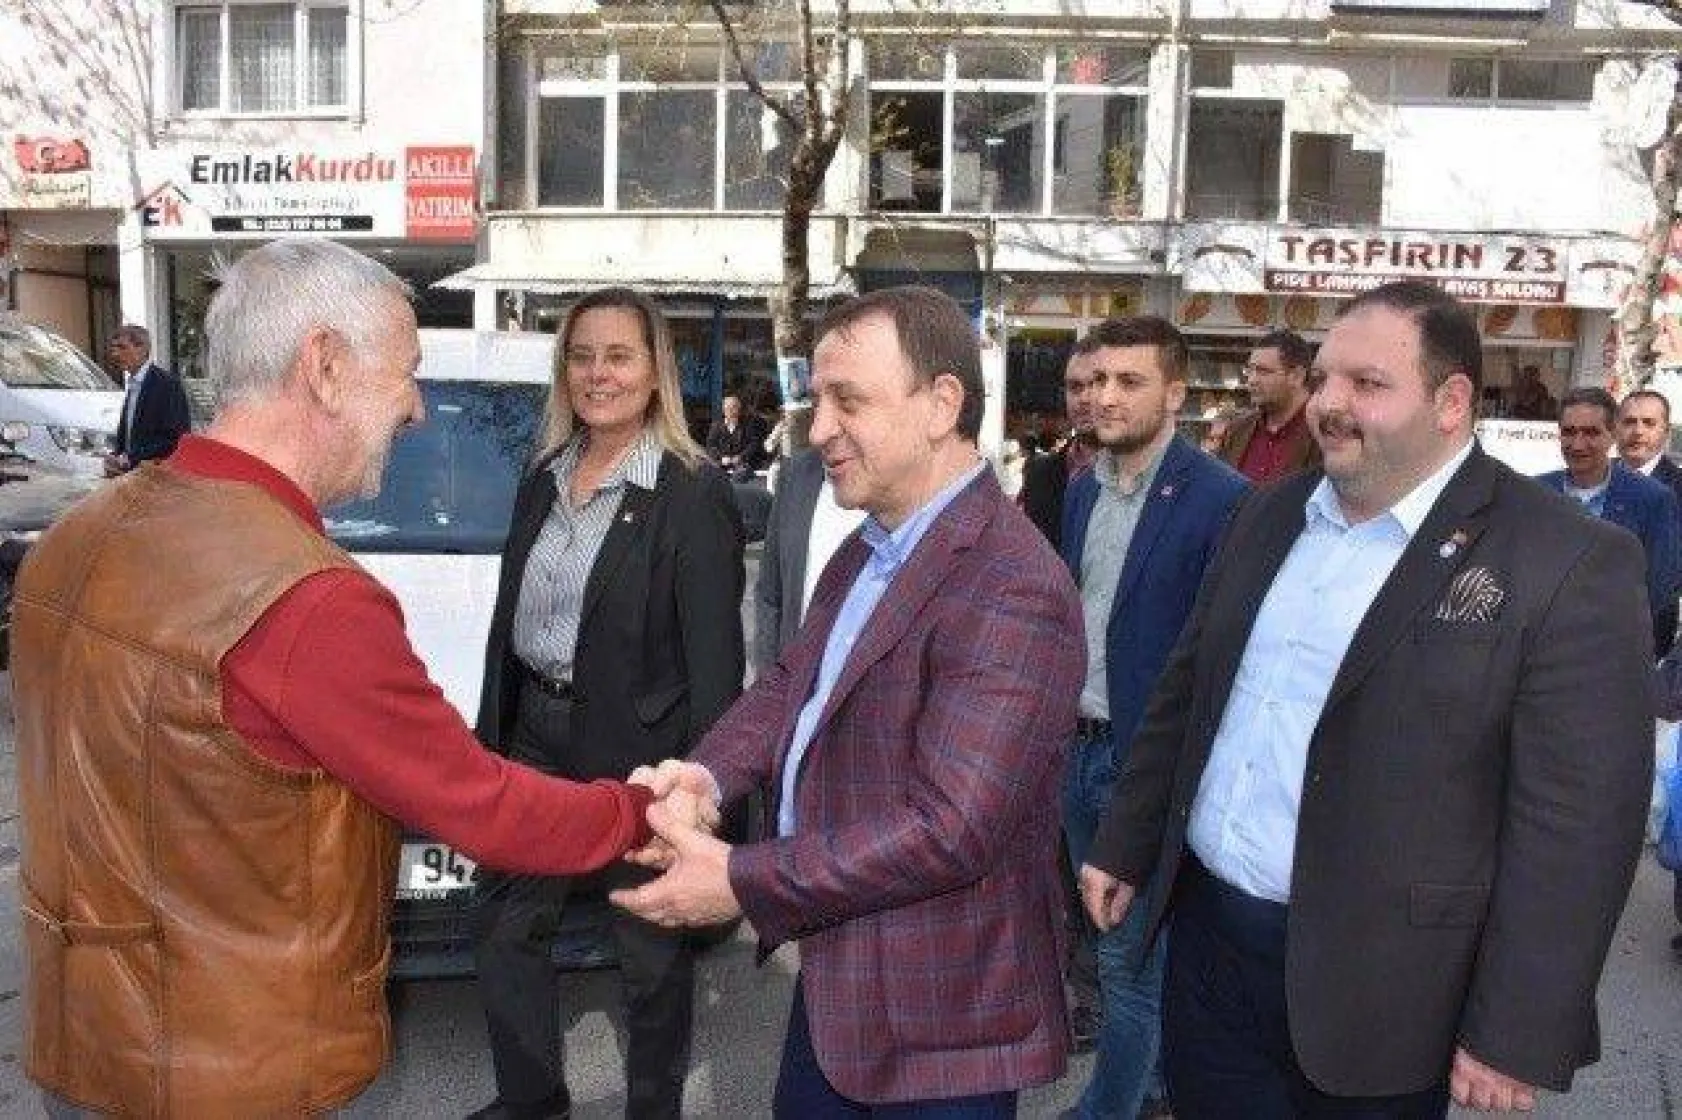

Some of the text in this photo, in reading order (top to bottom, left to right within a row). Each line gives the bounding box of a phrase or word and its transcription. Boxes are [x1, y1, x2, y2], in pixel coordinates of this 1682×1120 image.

[191, 152, 397, 184] EmlakKurdu
[407, 196, 474, 217] YATIRIM
[1503, 246, 1557, 273] 23
